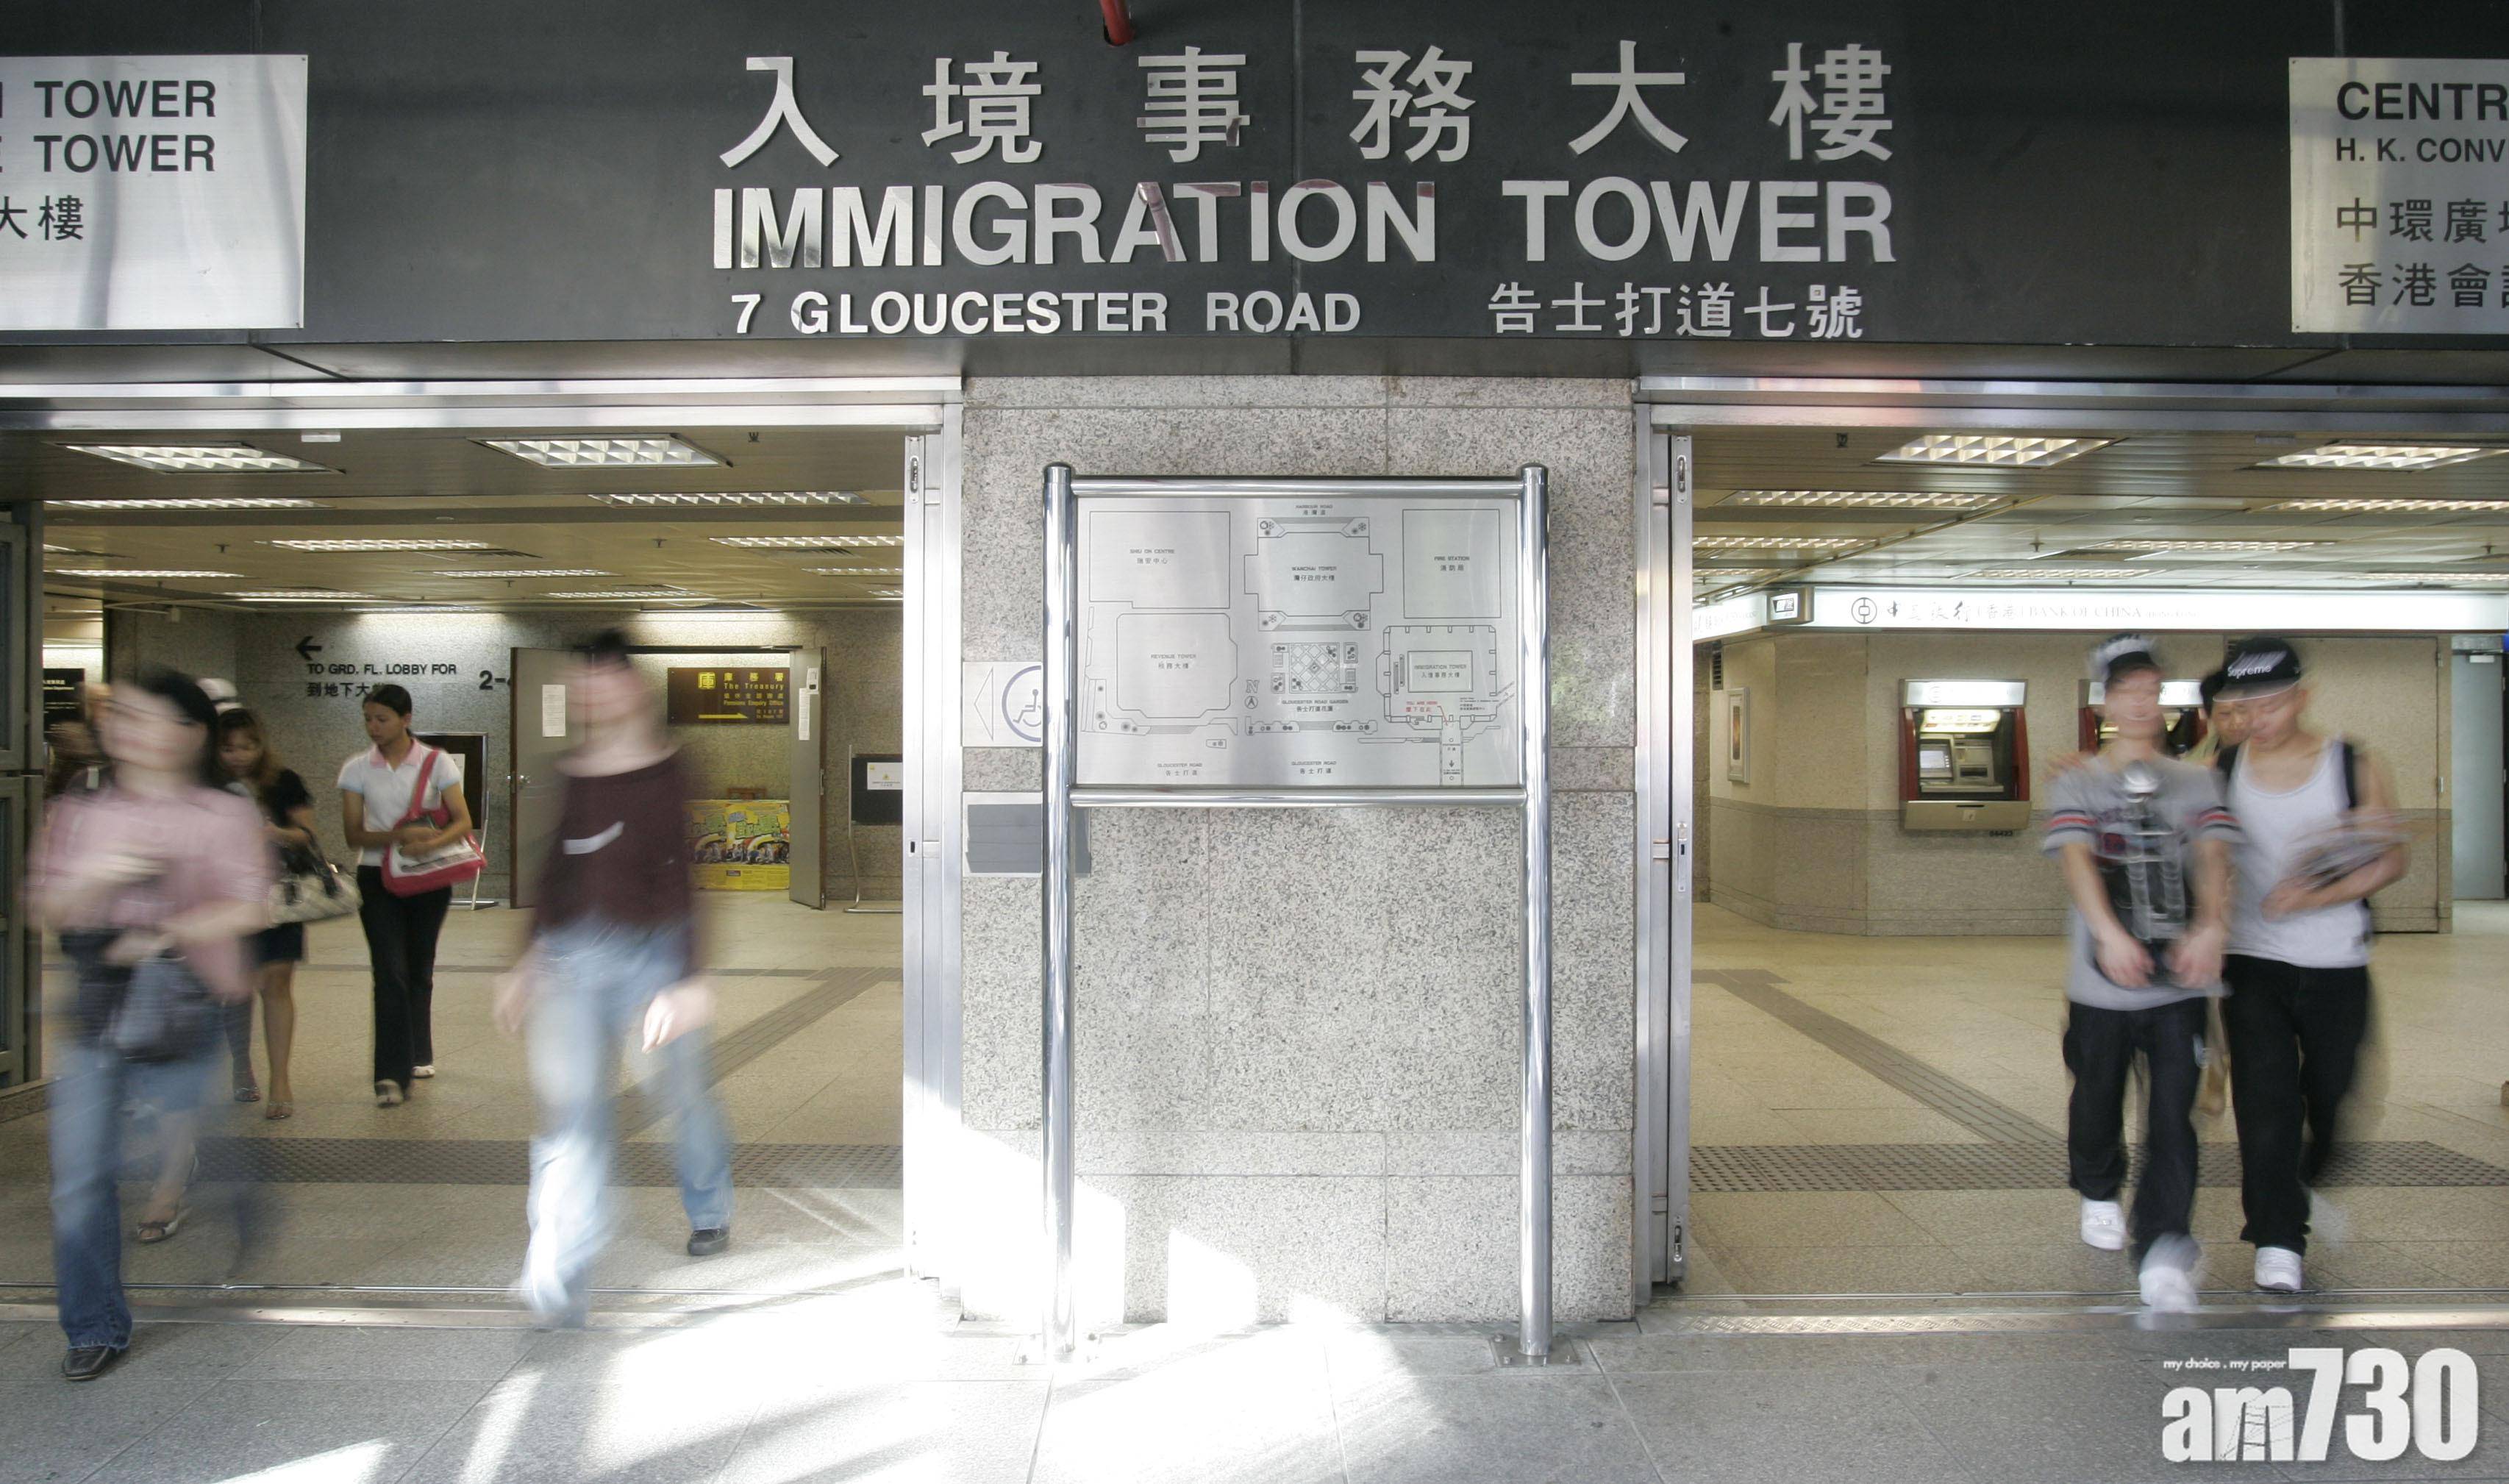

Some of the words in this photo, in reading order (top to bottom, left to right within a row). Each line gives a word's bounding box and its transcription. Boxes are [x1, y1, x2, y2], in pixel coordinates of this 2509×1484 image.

[34, 80, 216, 118] TOWER
[720, 40, 1894, 168] 入境事務大樓
[33, 135, 215, 172] TOWER
[2335, 138, 2365, 162] H.
[2377, 138, 2406, 162] K.
[2416, 138, 2509, 163] CONV
[713, 180, 1436, 269] IMMIGRATION
[1502, 176, 1897, 263] TOWER
[731, 293, 761, 334] 7
[790, 290, 1168, 335] GLOUCESTER
[1207, 291, 1360, 332] ROAD
[1488, 282, 1864, 339] 告士打道七號
[307, 663, 324, 674] TO
[328, 663, 359, 675] GRD.
[364, 663, 382, 675] FL.
[386, 663, 427, 675] LOBBY
[431, 663, 457, 674] FOR
[479, 670, 511, 690] 2-
[2227, 663, 2271, 679] Supreme
[307, 682, 384, 697] 到地下大
[744, 682, 785, 692] Treasury
